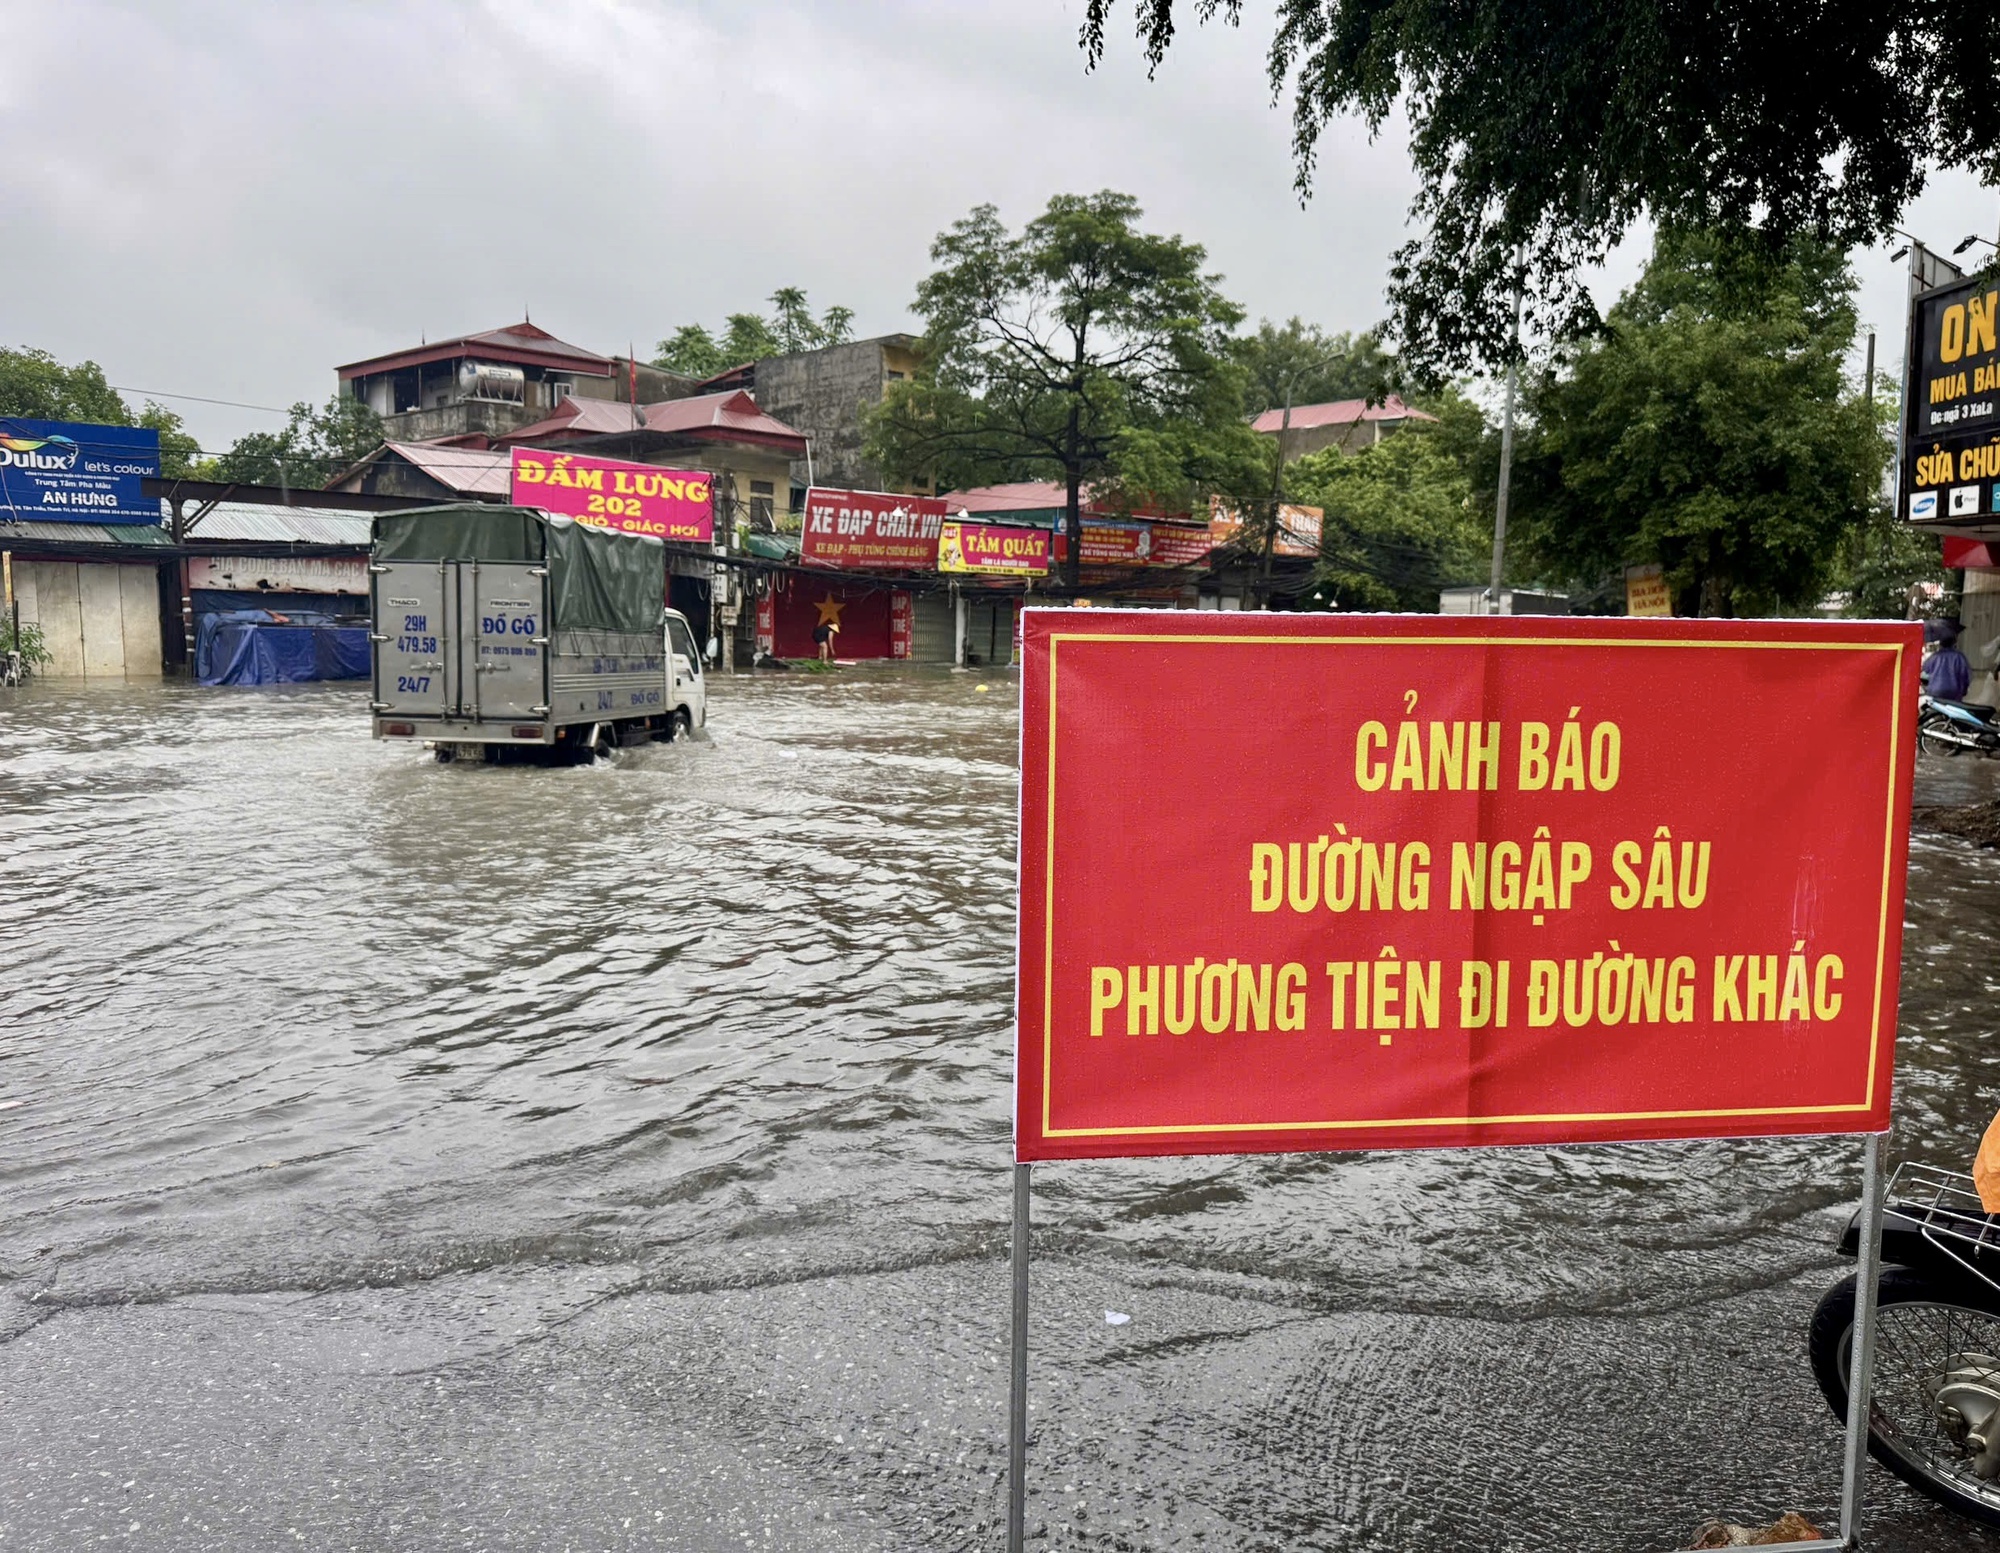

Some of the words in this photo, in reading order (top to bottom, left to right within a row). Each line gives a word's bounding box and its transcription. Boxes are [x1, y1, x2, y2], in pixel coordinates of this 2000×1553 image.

[1930, 372, 1967, 404] MUA
[1962, 404, 1969, 419] 3
[1970, 401, 1992, 418] XaLa
[85, 461, 111, 472] let's
[113, 463, 154, 475] colour
[1916, 443, 1954, 486] SỬA
[34, 479, 58, 487] Trung
[517, 456, 604, 491] ĐẤM
[614, 472, 710, 502] LƯNG
[42, 491, 67, 504] AN
[71, 492, 117, 506] HƯNG
[587, 494, 642, 516] 202
[622, 518, 666, 534] GIÁC
[670, 524, 699, 537] HƠI
[810, 506, 834, 534] XE
[837, 508, 873, 541] ĐẠP
[814, 542, 826, 554] XE
[827, 543, 844, 556] ĐẠP
[966, 528, 1000, 553] TẨM
[1003, 533, 1045, 558] QUẤT
[404, 615, 426, 632] 29H
[482, 612, 506, 634] ĐỒ
[511, 614, 538, 635] GỖ
[398, 637, 436, 653] 479.58
[398, 676, 430, 693] 24/7
[1355, 689, 1500, 792] CẢNH
[1519, 706, 1621, 792] BÁO
[1249, 823, 1431, 913] ĐƯỜNG
[1450, 826, 1592, 926] NGẬP
[1611, 825, 1711, 910] SÂU
[1090, 957, 1307, 1037] PHƯƠNG
[1327, 945, 1441, 1046] TIỆN
[1459, 960, 1510, 1028] ĐI
[1527, 940, 1696, 1027] ĐƯỜNG
[1713, 940, 1844, 1022] KHÁC
